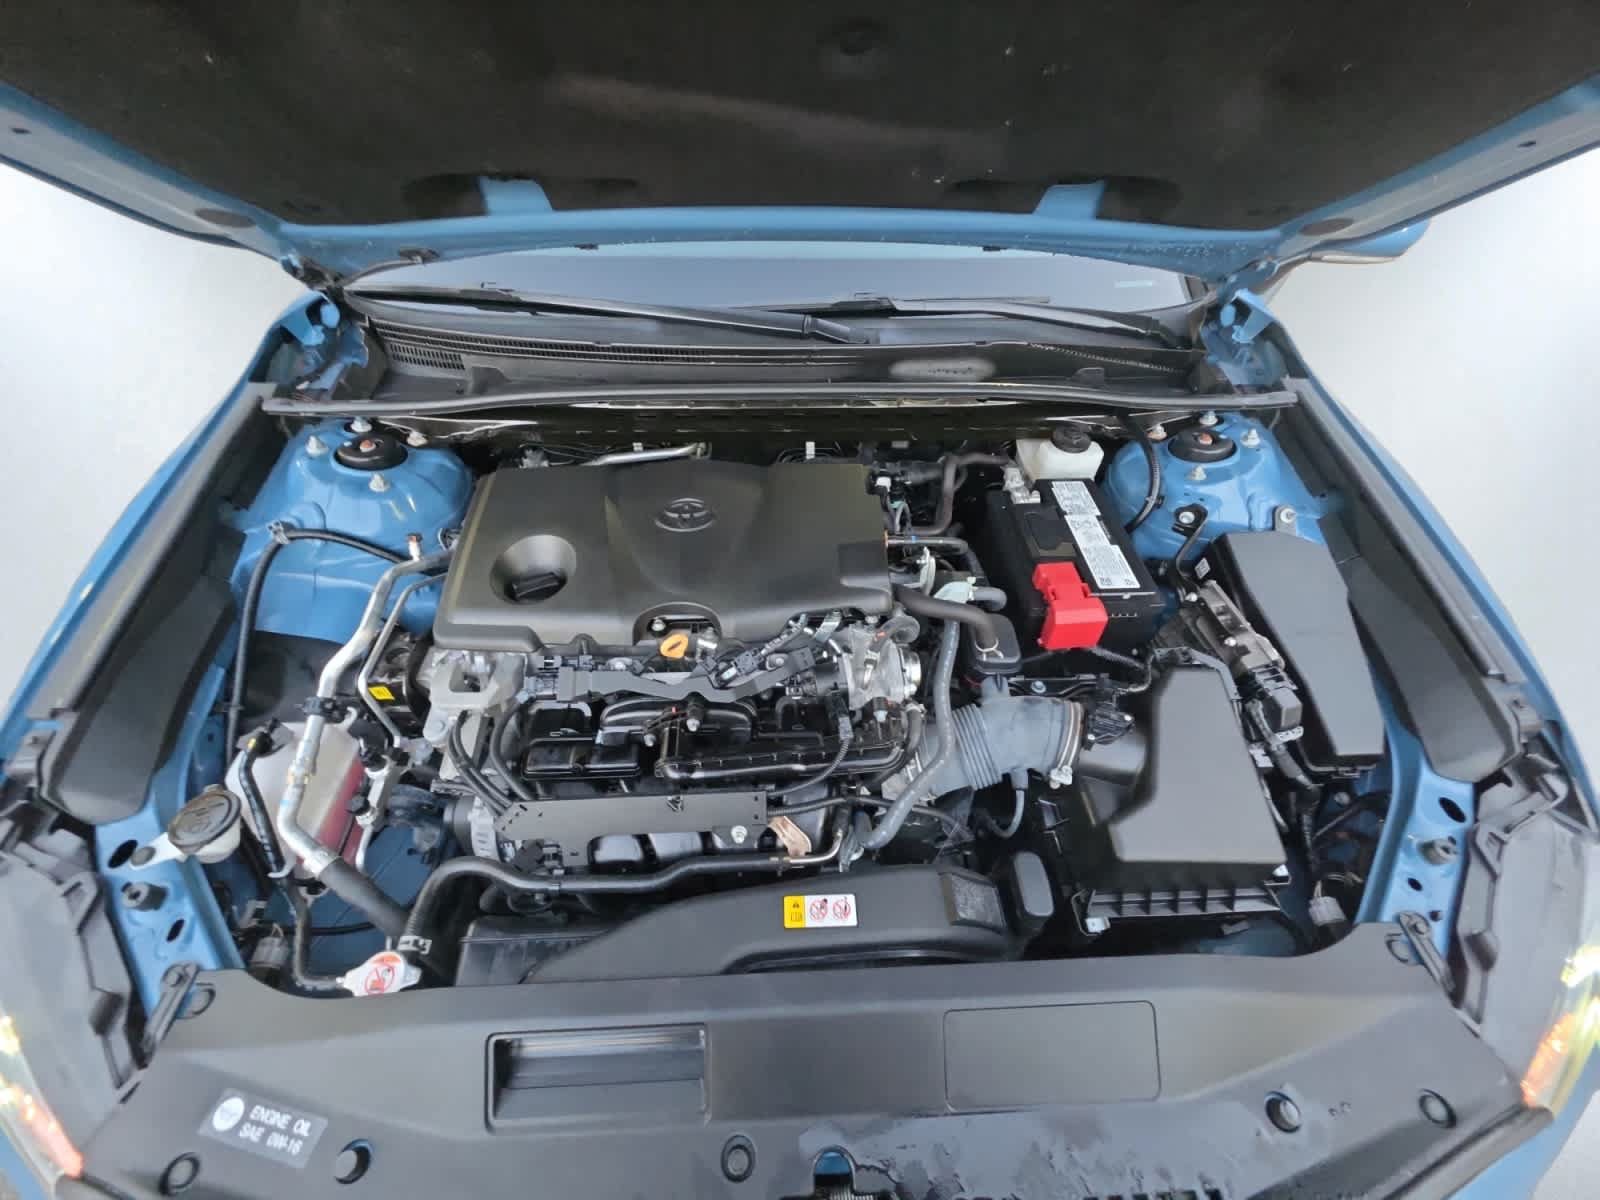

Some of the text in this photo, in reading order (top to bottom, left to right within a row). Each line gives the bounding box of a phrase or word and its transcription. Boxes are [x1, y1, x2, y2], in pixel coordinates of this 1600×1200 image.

[239, 1123, 265, 1143] SAE
[249, 1105, 312, 1136] ENGINE OIL
